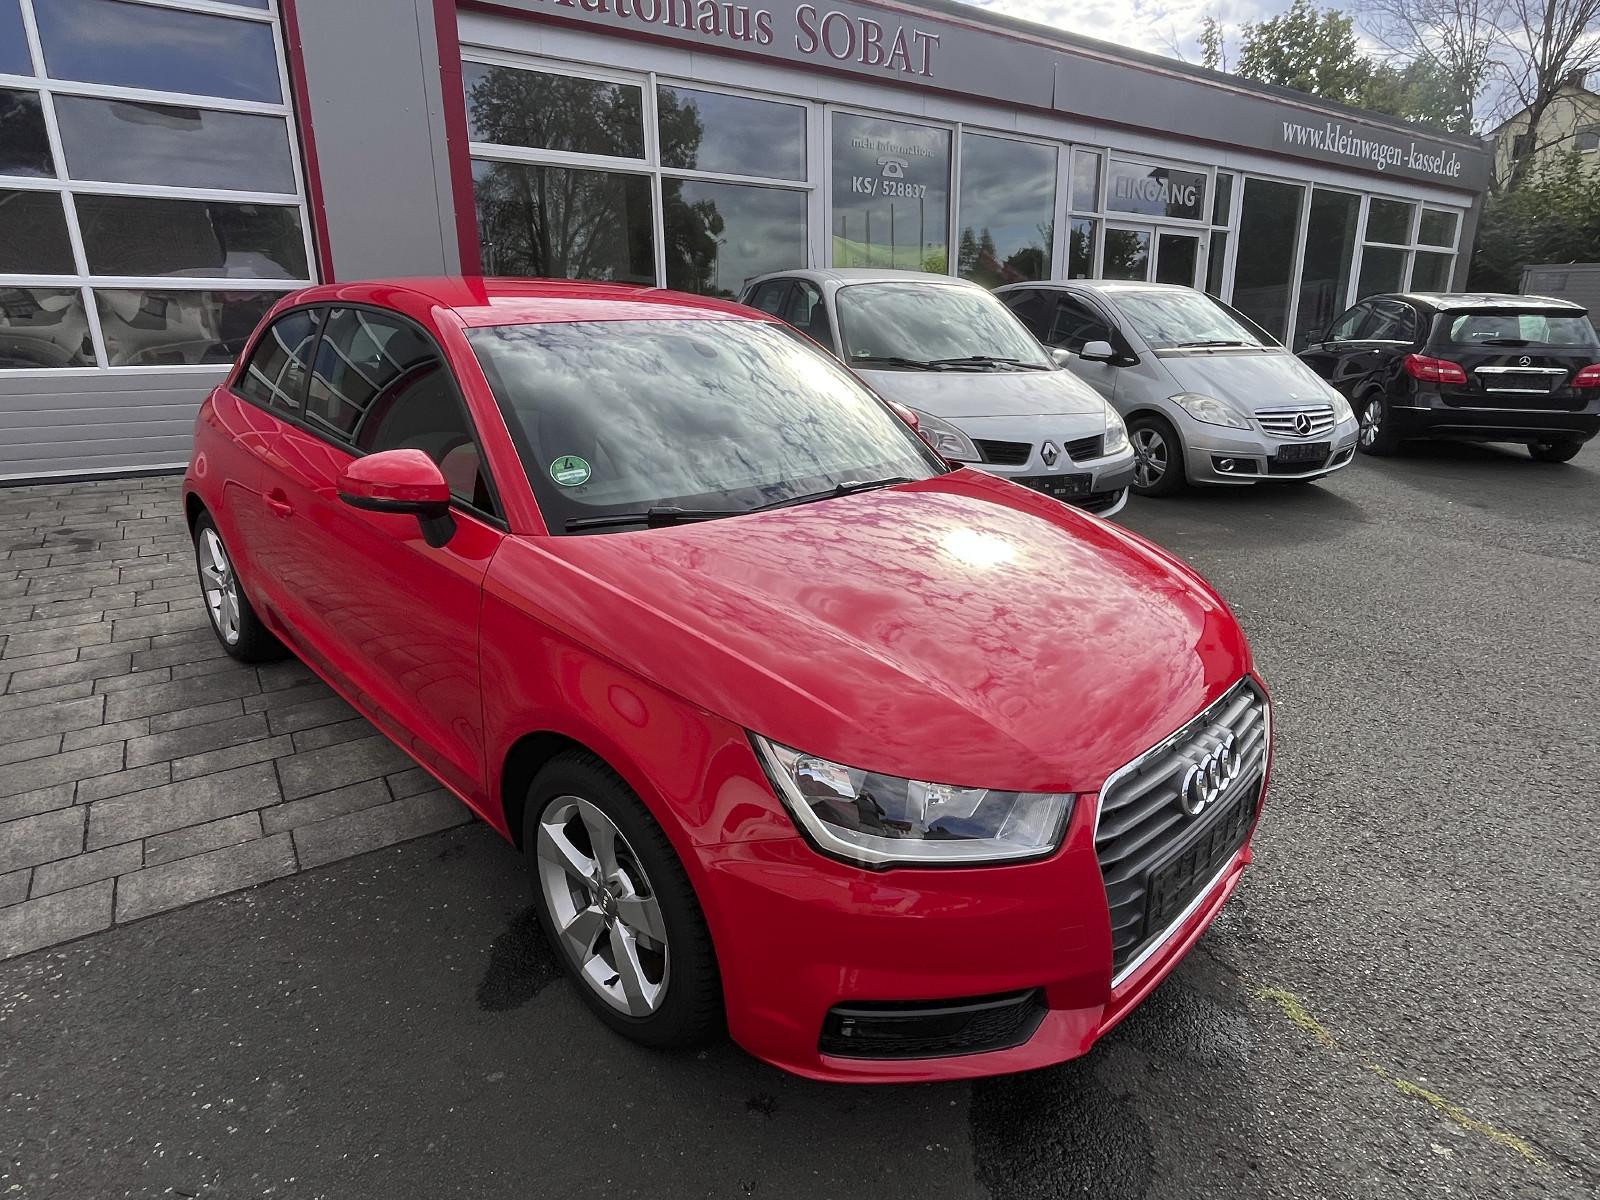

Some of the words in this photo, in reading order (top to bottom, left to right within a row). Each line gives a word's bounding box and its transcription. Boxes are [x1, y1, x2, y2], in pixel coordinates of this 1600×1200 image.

[538, 0, 774, 46] ohaus
[795, 4, 940, 77] SOBAT
[1282, 121, 1461, 177] www.kleinwagen-kassel.de
[852, 176, 878, 197] KS/
[882, 181, 927, 199] 528837
[1116, 175, 1196, 207] EINGANG
